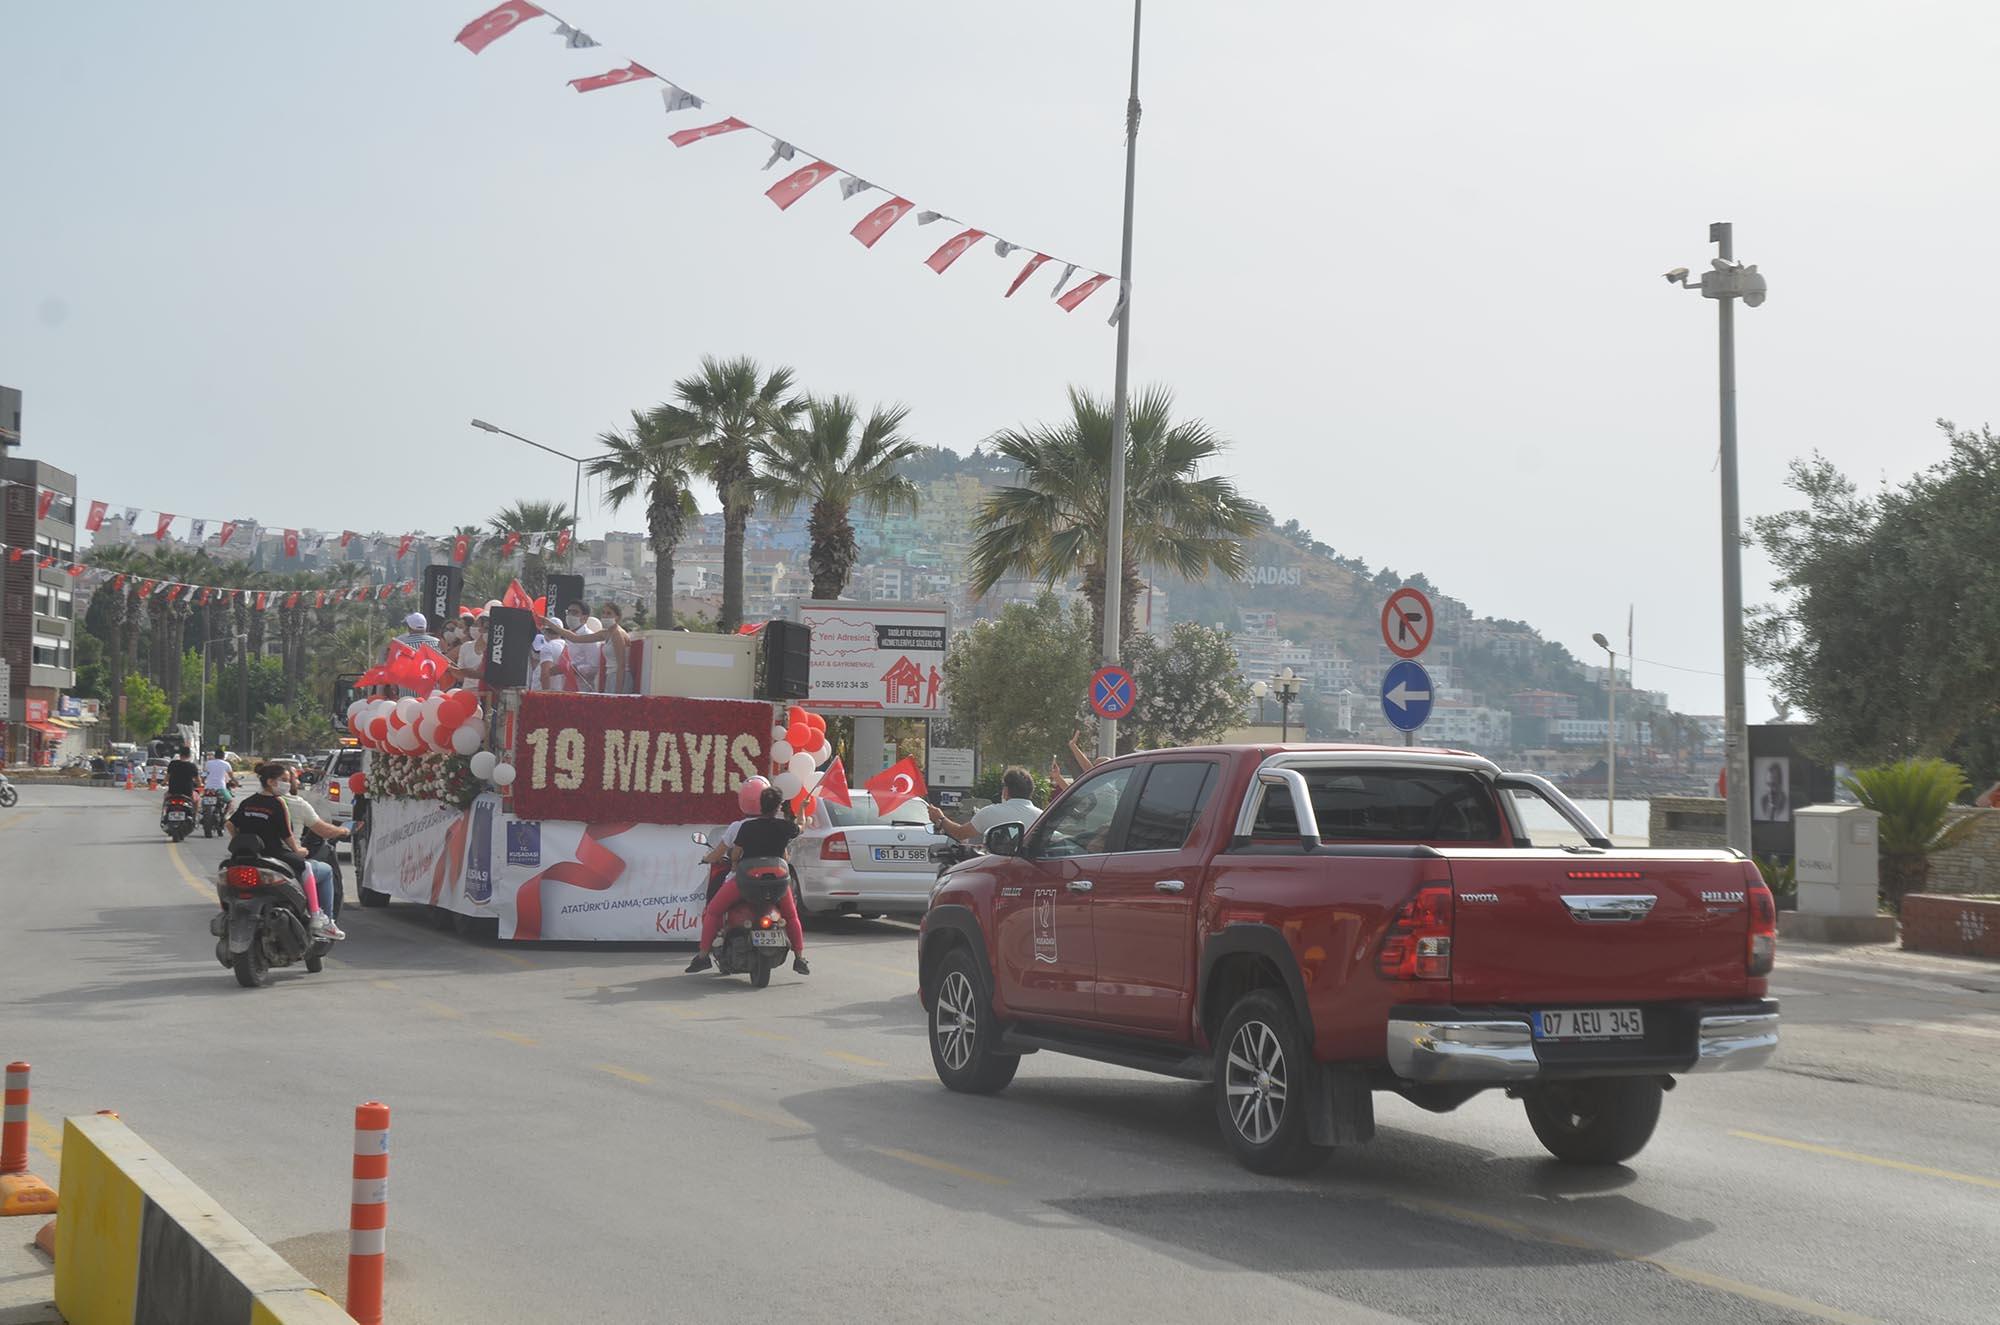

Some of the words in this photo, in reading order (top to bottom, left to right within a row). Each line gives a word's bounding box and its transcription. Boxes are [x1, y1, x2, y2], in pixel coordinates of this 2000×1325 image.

[1241, 566, 1300, 589] ŞADASI
[435, 574, 448, 618] ADASES
[492, 624, 504, 665] ADASES
[819, 632, 835, 641] Yeni
[837, 632, 871, 642] Adresiniz
[815, 680, 820, 688] 0
[821, 681, 835, 689] 256
[836, 681, 849, 689] 512
[849, 681, 858, 689] 34
[859, 681, 869, 689] 35
[526, 728, 585, 790] 19
[603, 729, 761, 794] MAYIS
[893, 849, 905, 859] BJ
[908, 850, 925, 859] 585
[560, 900, 610, 914] ATATÜRK'Ü
[642, 893, 678, 906] GENÇLİK
[689, 892, 707, 902] SPO
[1460, 893, 1499, 902] TOYOTA
[1701, 891, 1745, 903] HILUX
[656, 907, 697, 934] Kutlu
[1543, 1013, 1562, 1034] 07
[1573, 1012, 1602, 1034] AEU
[1609, 1011, 1640, 1033] 345
